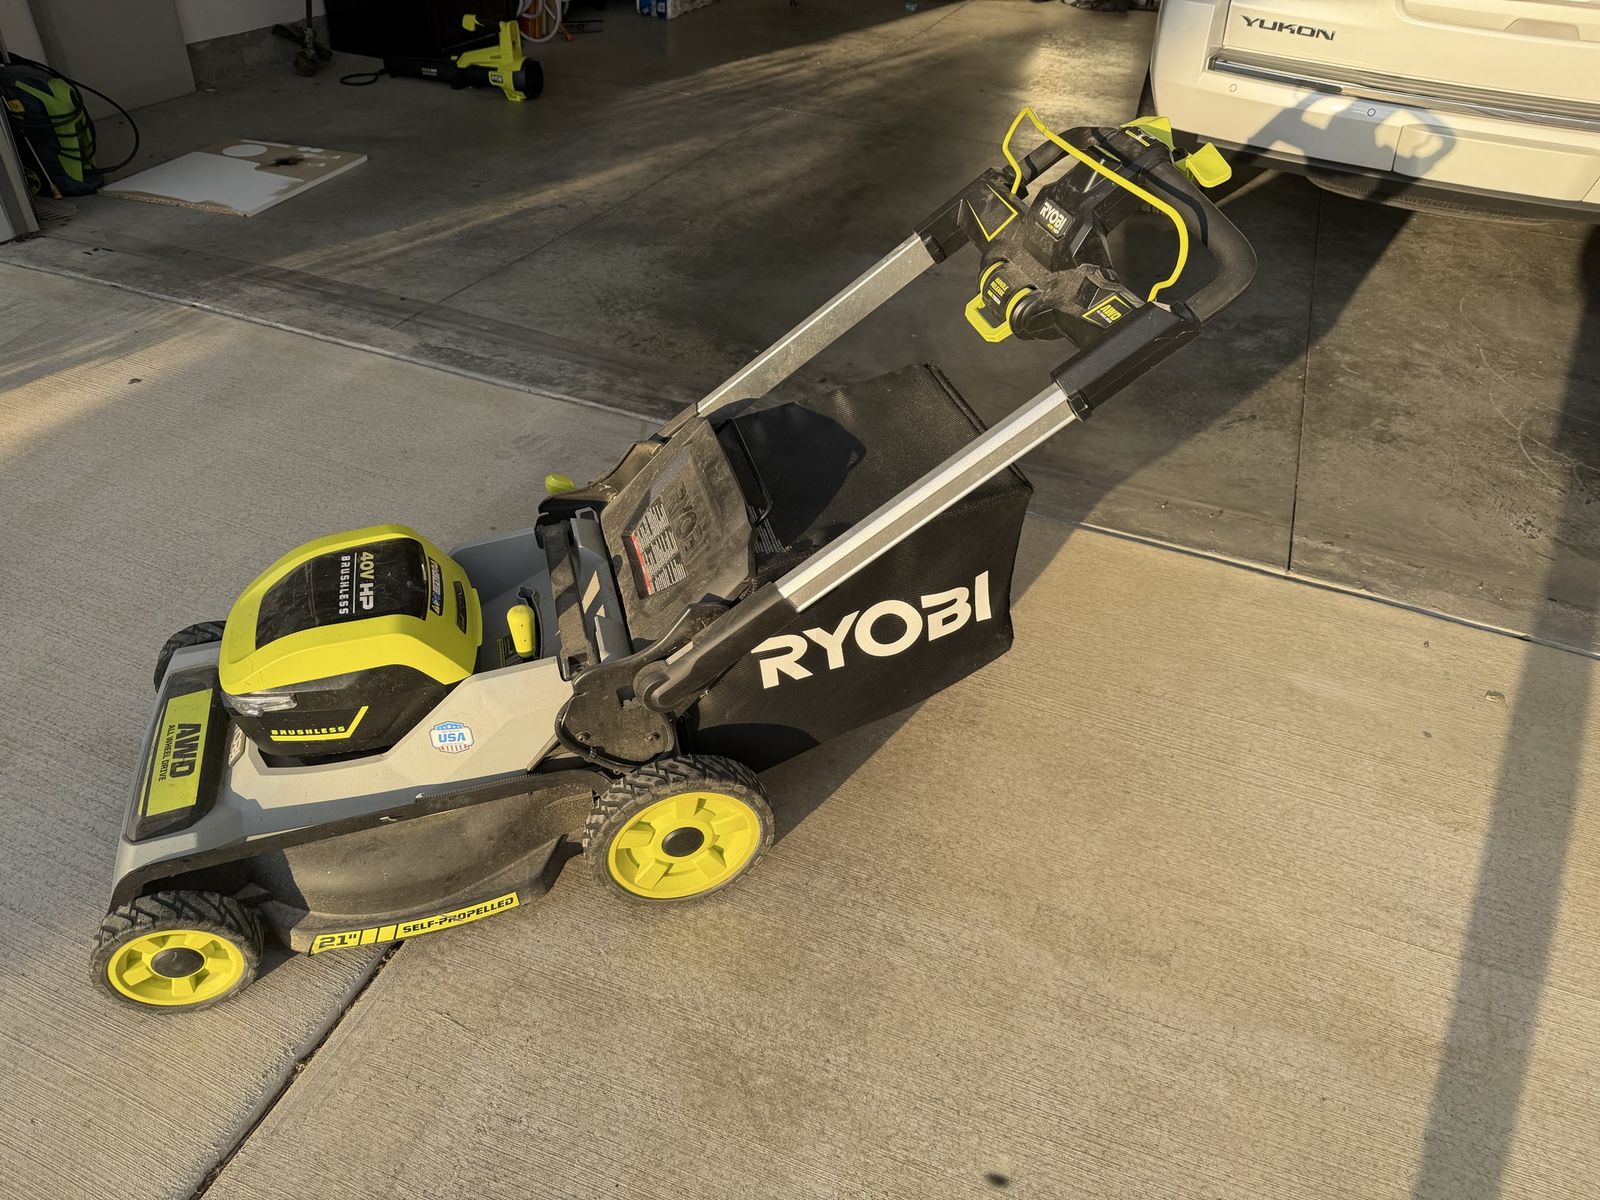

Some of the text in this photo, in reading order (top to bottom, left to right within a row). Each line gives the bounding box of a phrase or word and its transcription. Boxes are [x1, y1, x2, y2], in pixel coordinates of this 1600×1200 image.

[1241, 14, 1336, 41] YUKON
[1040, 201, 1067, 231] RYOBI
[1100, 304, 1122, 320] AWD
[339, 555, 351, 614] BRUSHLESS
[360, 551, 375, 610] 40V HP
[751, 570, 992, 689] RYOBI
[159, 724, 176, 782] ALL WHEEL DRIVE
[169, 723, 202, 778] AWD
[270, 726, 346, 735] BRUSHLESS
[438, 732, 466, 743] USA
[319, 897, 514, 949] 21" SELF-PROPELLED
